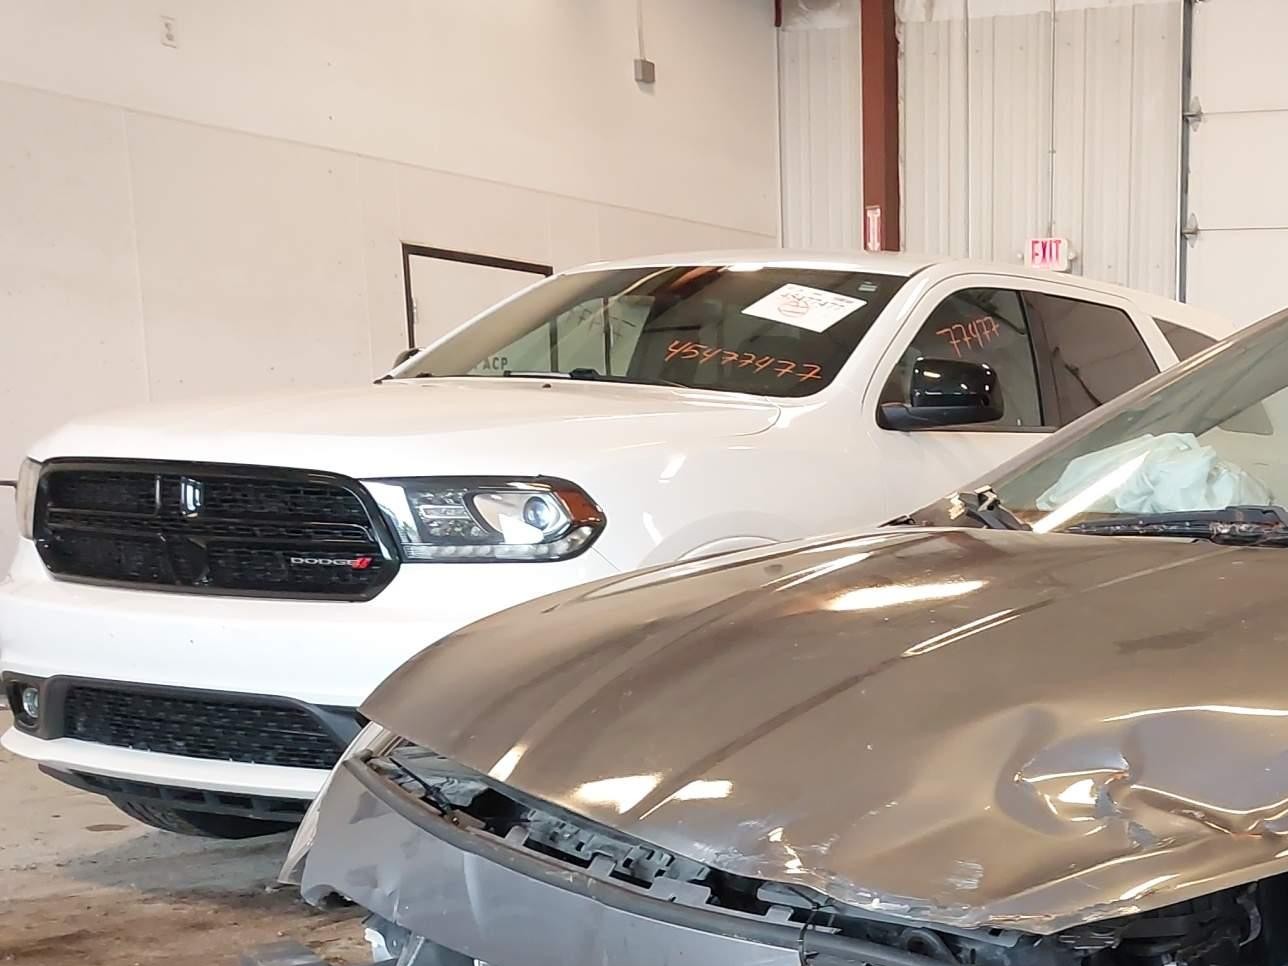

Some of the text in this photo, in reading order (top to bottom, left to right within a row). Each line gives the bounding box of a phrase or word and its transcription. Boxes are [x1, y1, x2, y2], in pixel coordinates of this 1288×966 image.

[1031, 239, 1062, 266] EXIT
[935, 315, 1000, 358] 77477
[664, 340, 822, 383] 45477477
